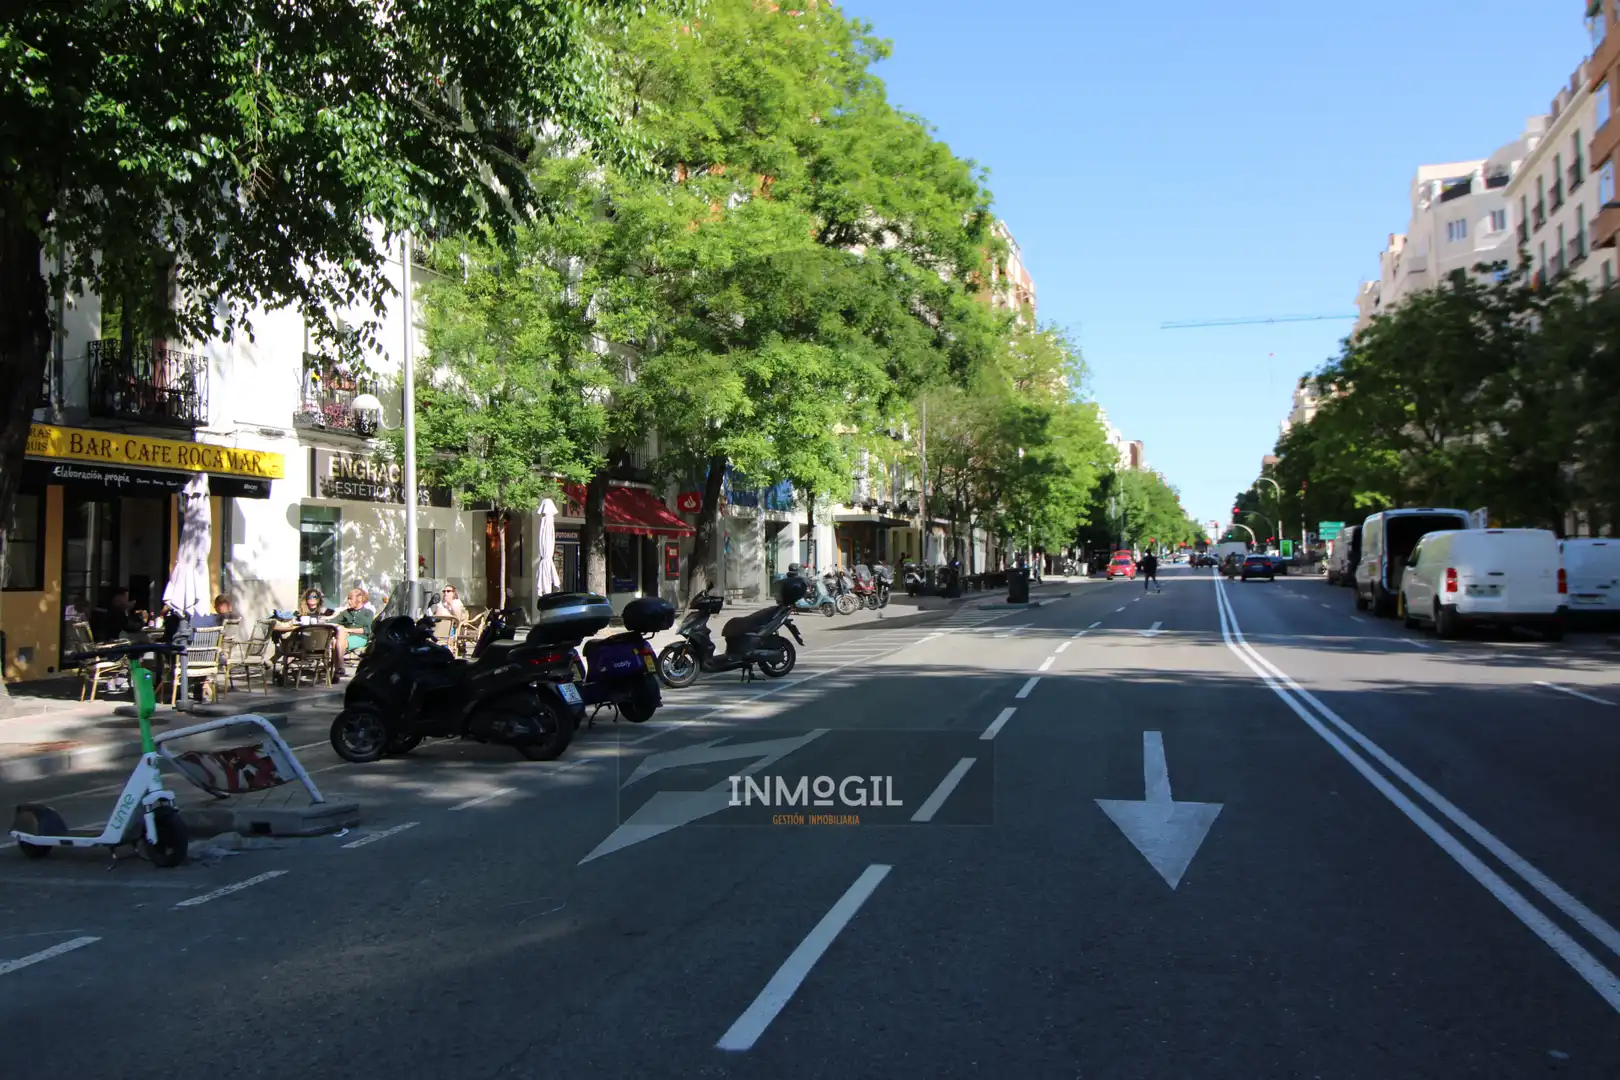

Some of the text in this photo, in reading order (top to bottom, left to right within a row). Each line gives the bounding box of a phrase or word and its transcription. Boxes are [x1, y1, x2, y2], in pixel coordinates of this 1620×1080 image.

[70, 433, 263, 473] BAR CAFE ROCAMAR
[53, 465, 103, 481] Elaboración
[102, 473, 130, 488] propia
[328, 455, 405, 484] ENGRACI
[335, 481, 392, 498] ESTÉTICA
[401, 487, 430, 502] UAS
